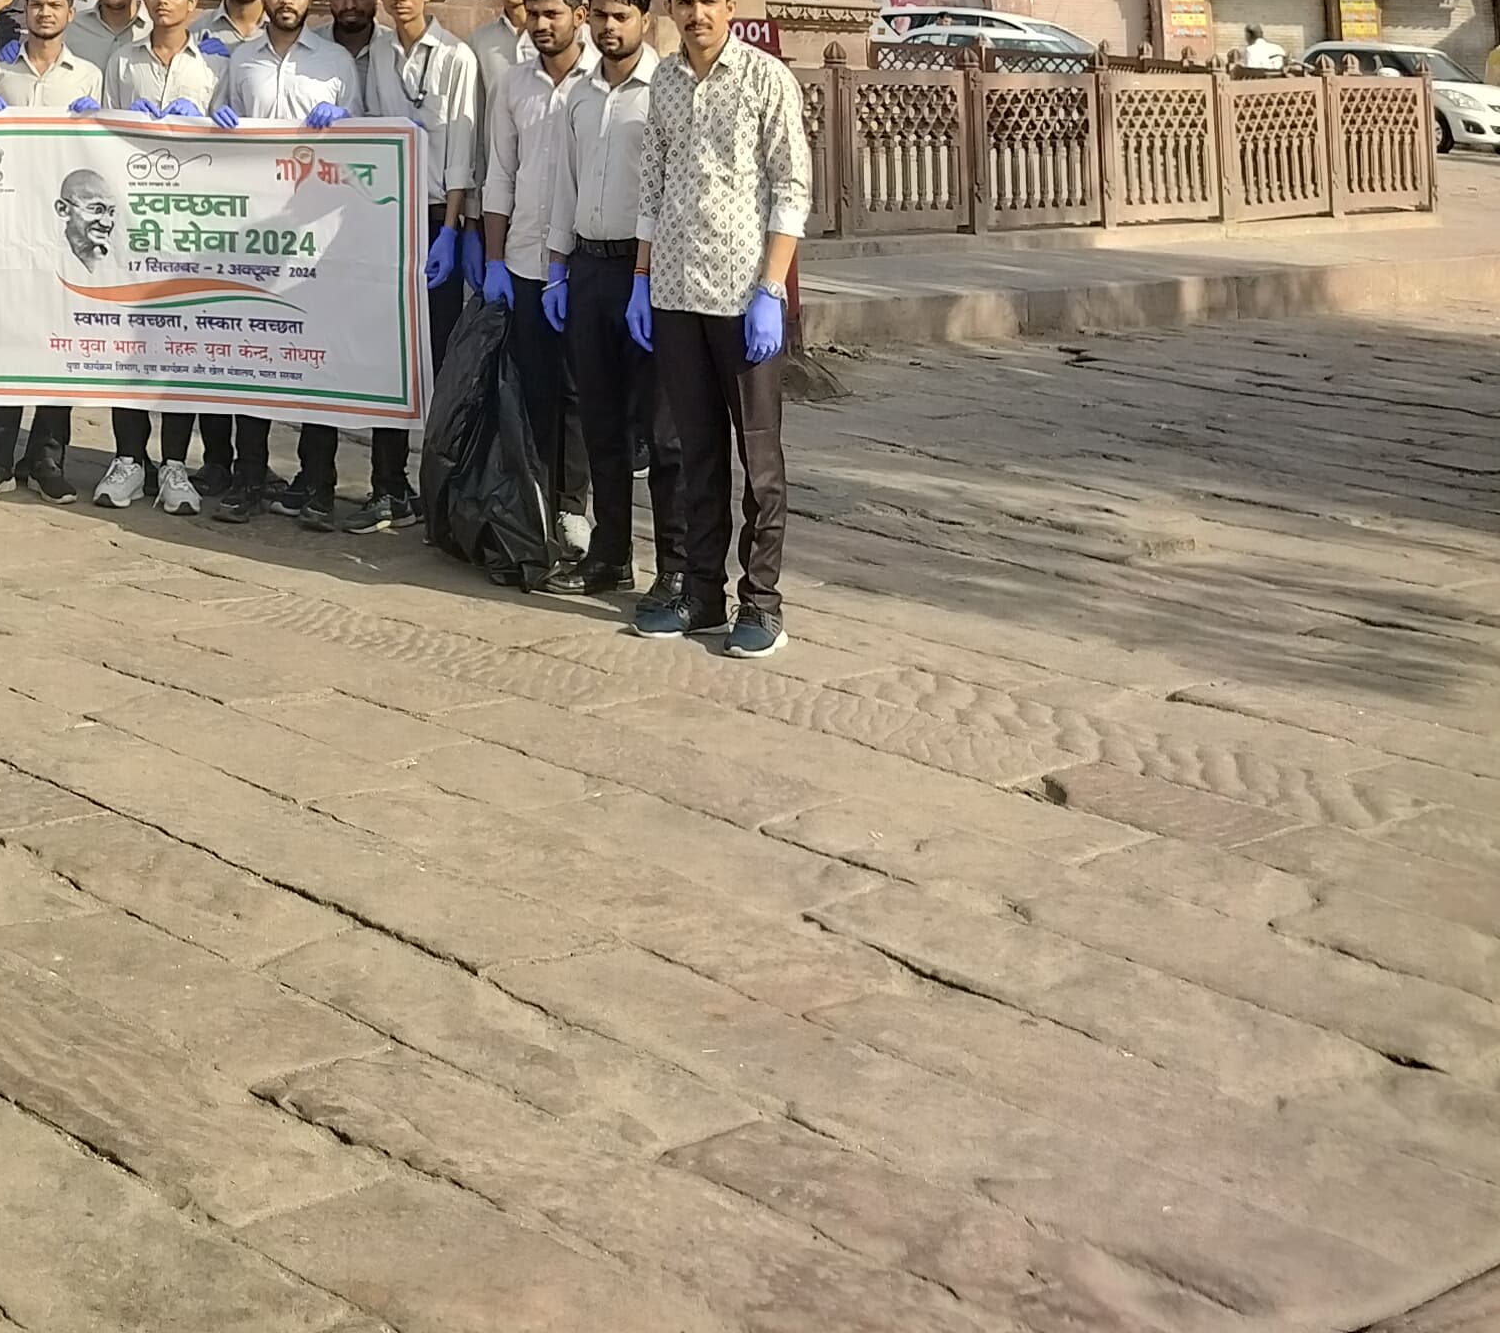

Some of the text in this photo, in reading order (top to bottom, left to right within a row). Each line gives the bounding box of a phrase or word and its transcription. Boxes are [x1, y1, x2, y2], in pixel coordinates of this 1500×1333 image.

[128, 193, 250, 218] स्वच्छता
[127, 219, 316, 257] ही सेवा 2024
[128, 261, 141, 271] 17
[145, 257, 200, 274] सितम्बर
[216, 263, 224, 274] 2
[228, 263, 281, 281] अक्टूबर
[289, 266, 317, 279] 2024
[74, 309, 304, 334] स्वभाव स्वच्छता, संस्कार स्वच्छता
[50, 333, 72, 351] मेरा
[79, 339, 106, 357] युवा
[113, 340, 147, 354] भारत
[164, 335, 197, 356] नेहरू
[204, 343, 231, 362] युवा
[238, 339, 273, 363] केन्द्र,
[279, 342, 326, 369] जोधपुर
[66, 362, 80, 372] युवा
[143, 364, 157, 374] युवा
